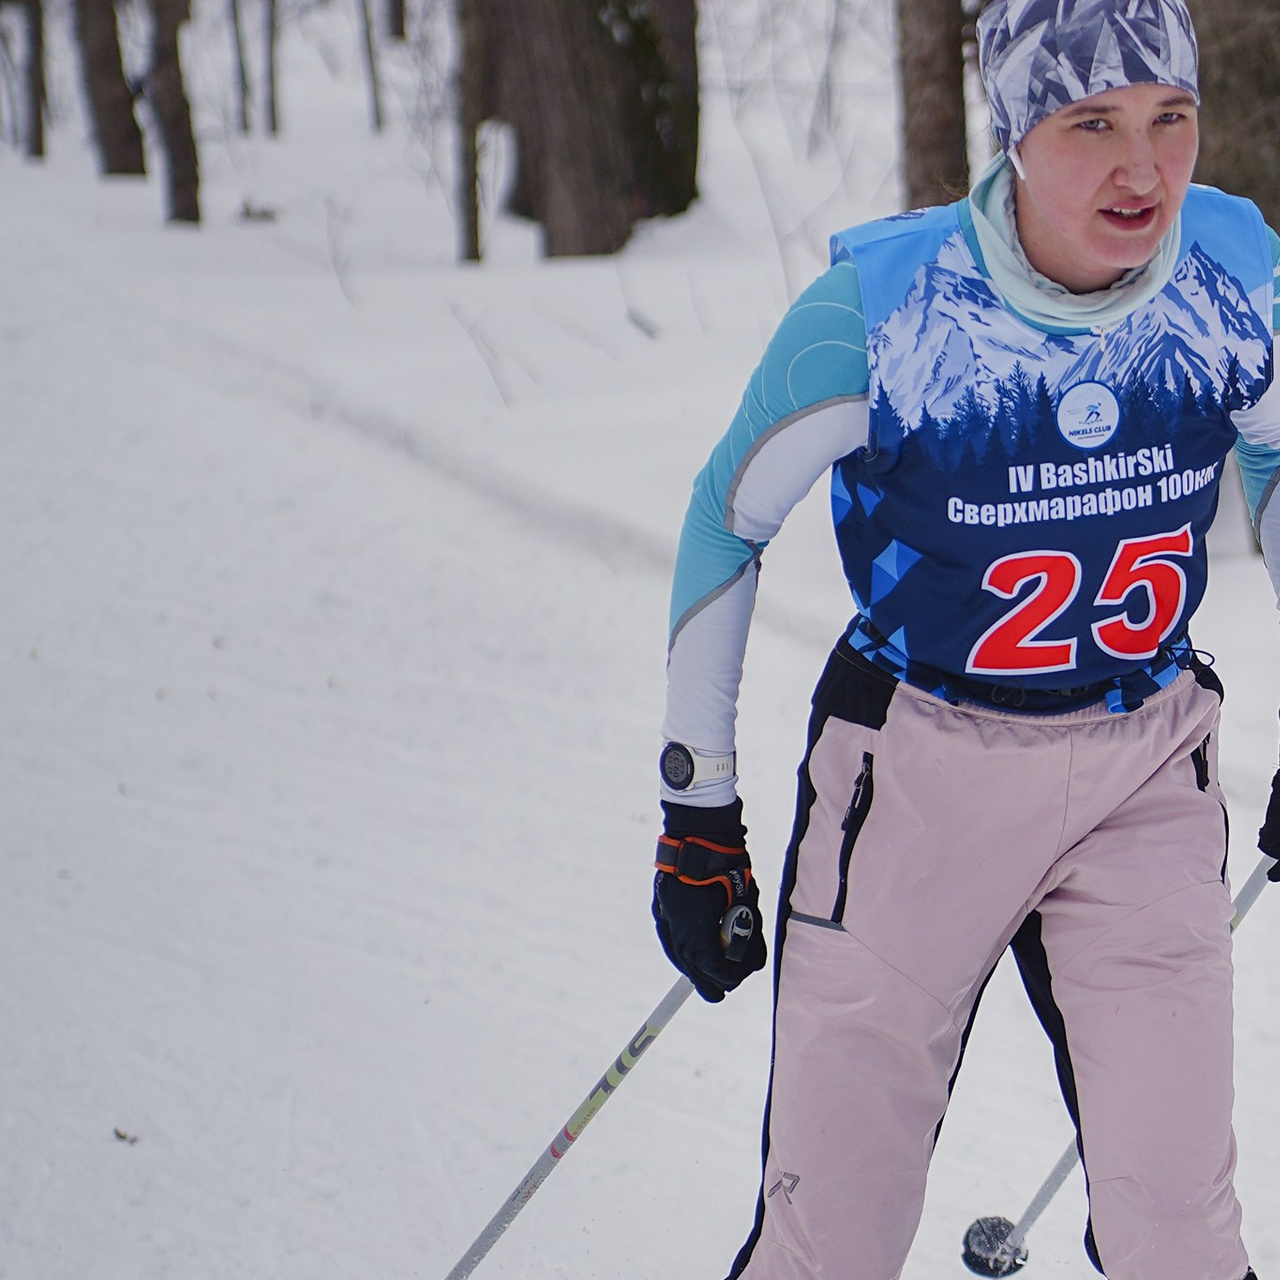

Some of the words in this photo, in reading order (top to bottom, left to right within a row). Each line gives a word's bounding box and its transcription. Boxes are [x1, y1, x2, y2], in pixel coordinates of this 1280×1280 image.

[1094, 425, 1112, 434] CLUB
[1008, 464, 1034, 494] IV
[1040, 443, 1175, 491] BashkirSki
[947, 484, 1153, 527] Сверхмарафон
[965, 522, 1193, 676] 25
